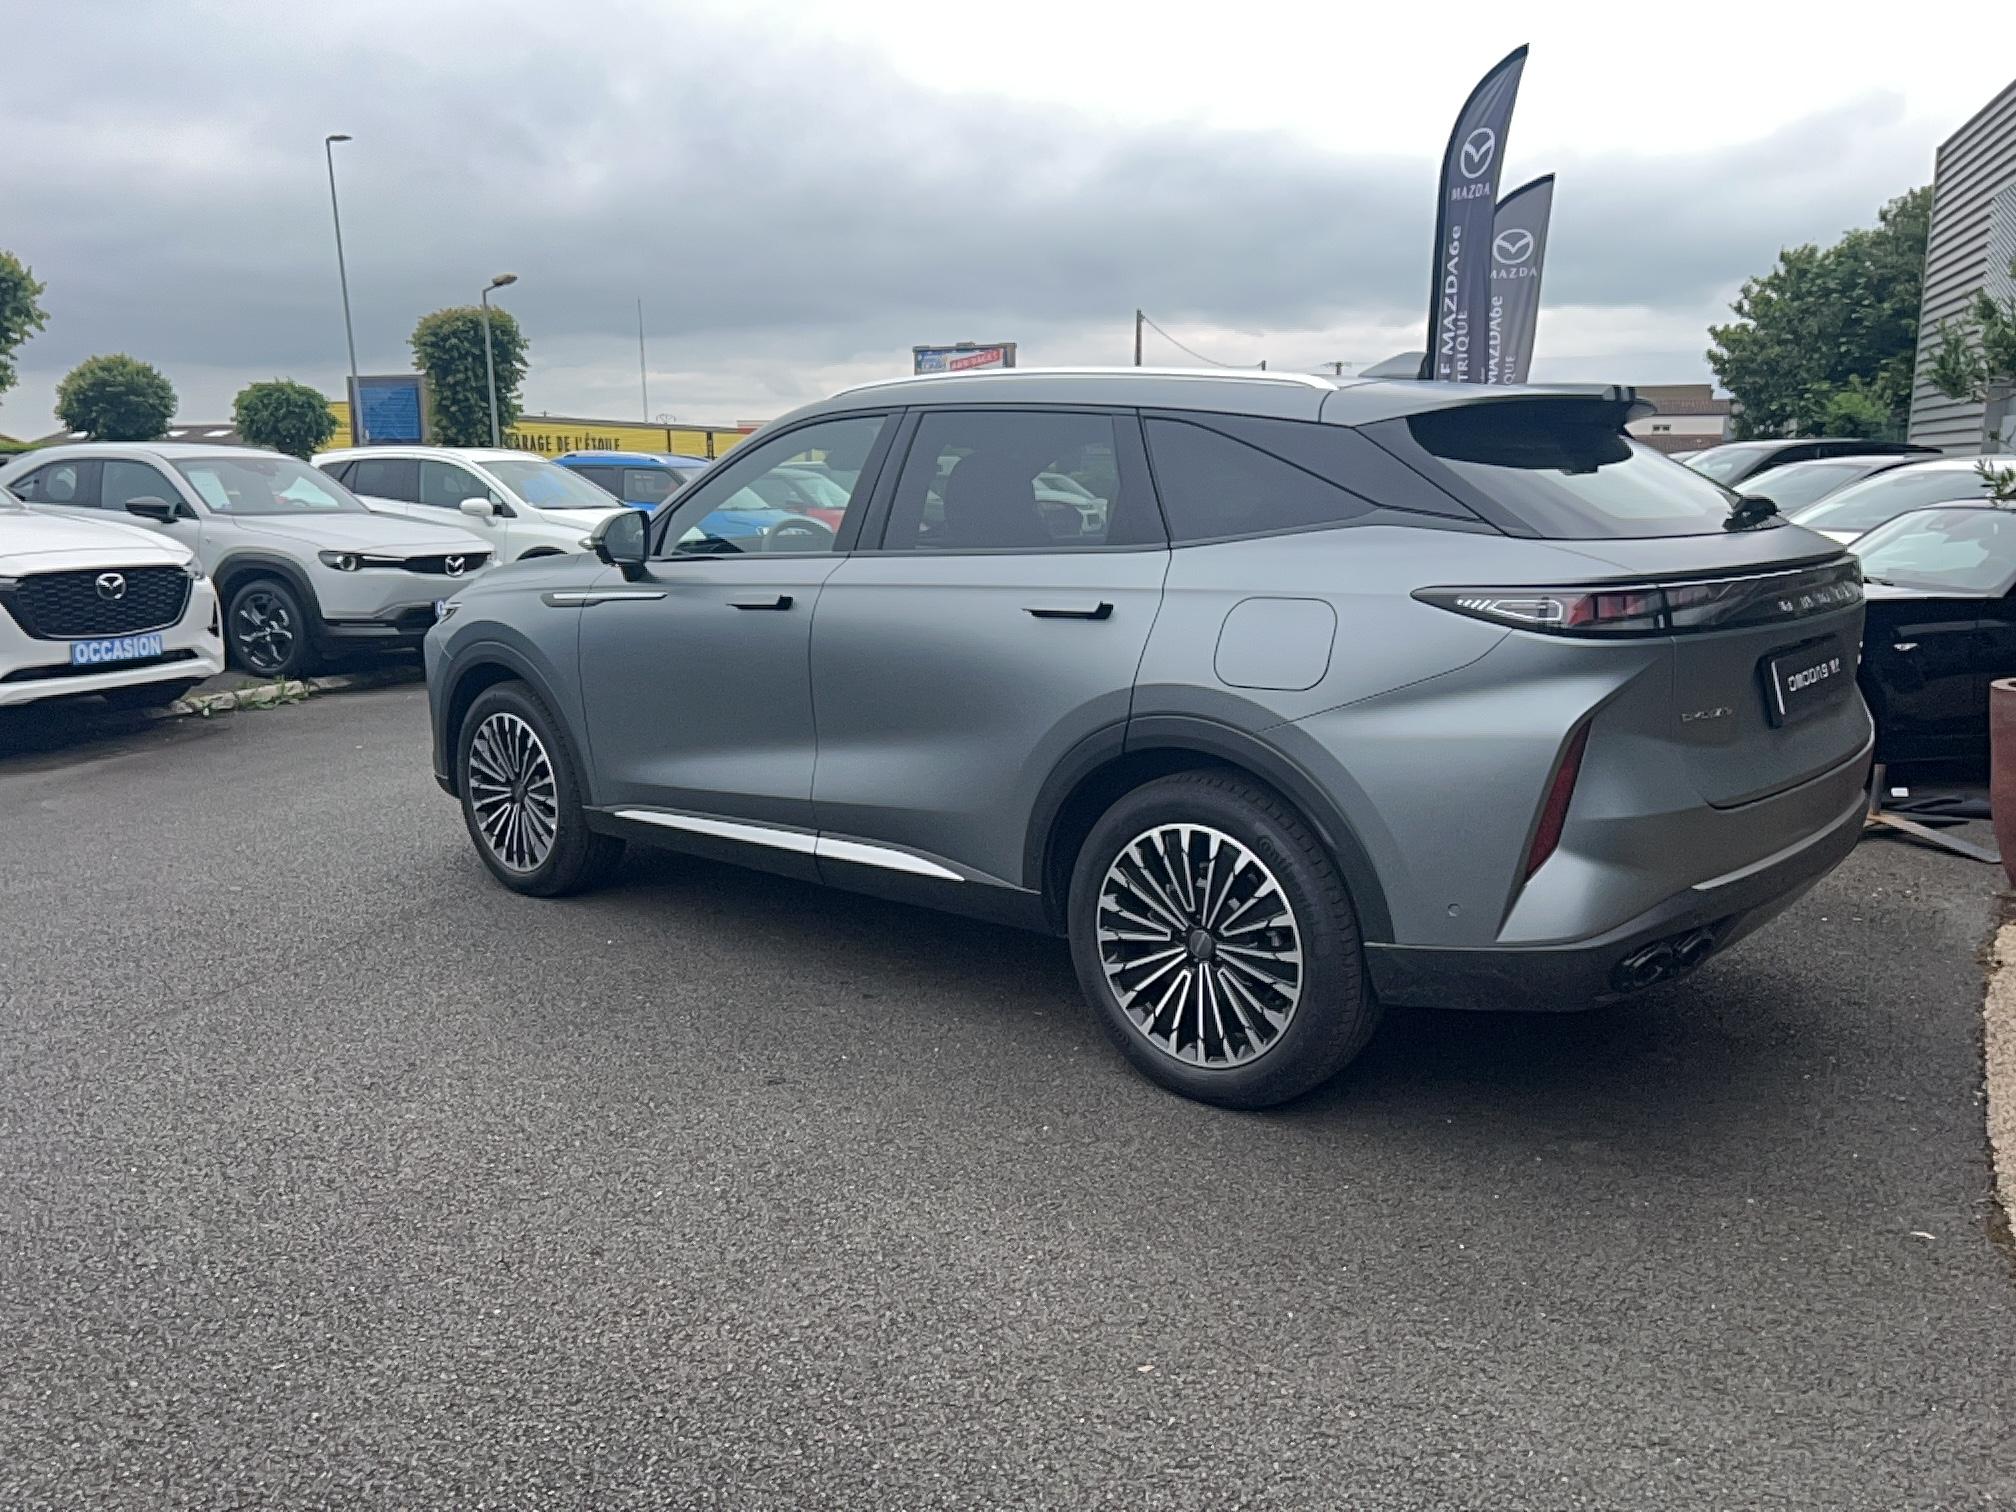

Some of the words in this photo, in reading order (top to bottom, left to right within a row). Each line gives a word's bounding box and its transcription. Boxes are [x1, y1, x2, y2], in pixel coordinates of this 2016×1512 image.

[1451, 182, 1490, 200] MAZDA
[557, 436, 571, 453] DE
[75, 634, 162, 664] OCCASION
